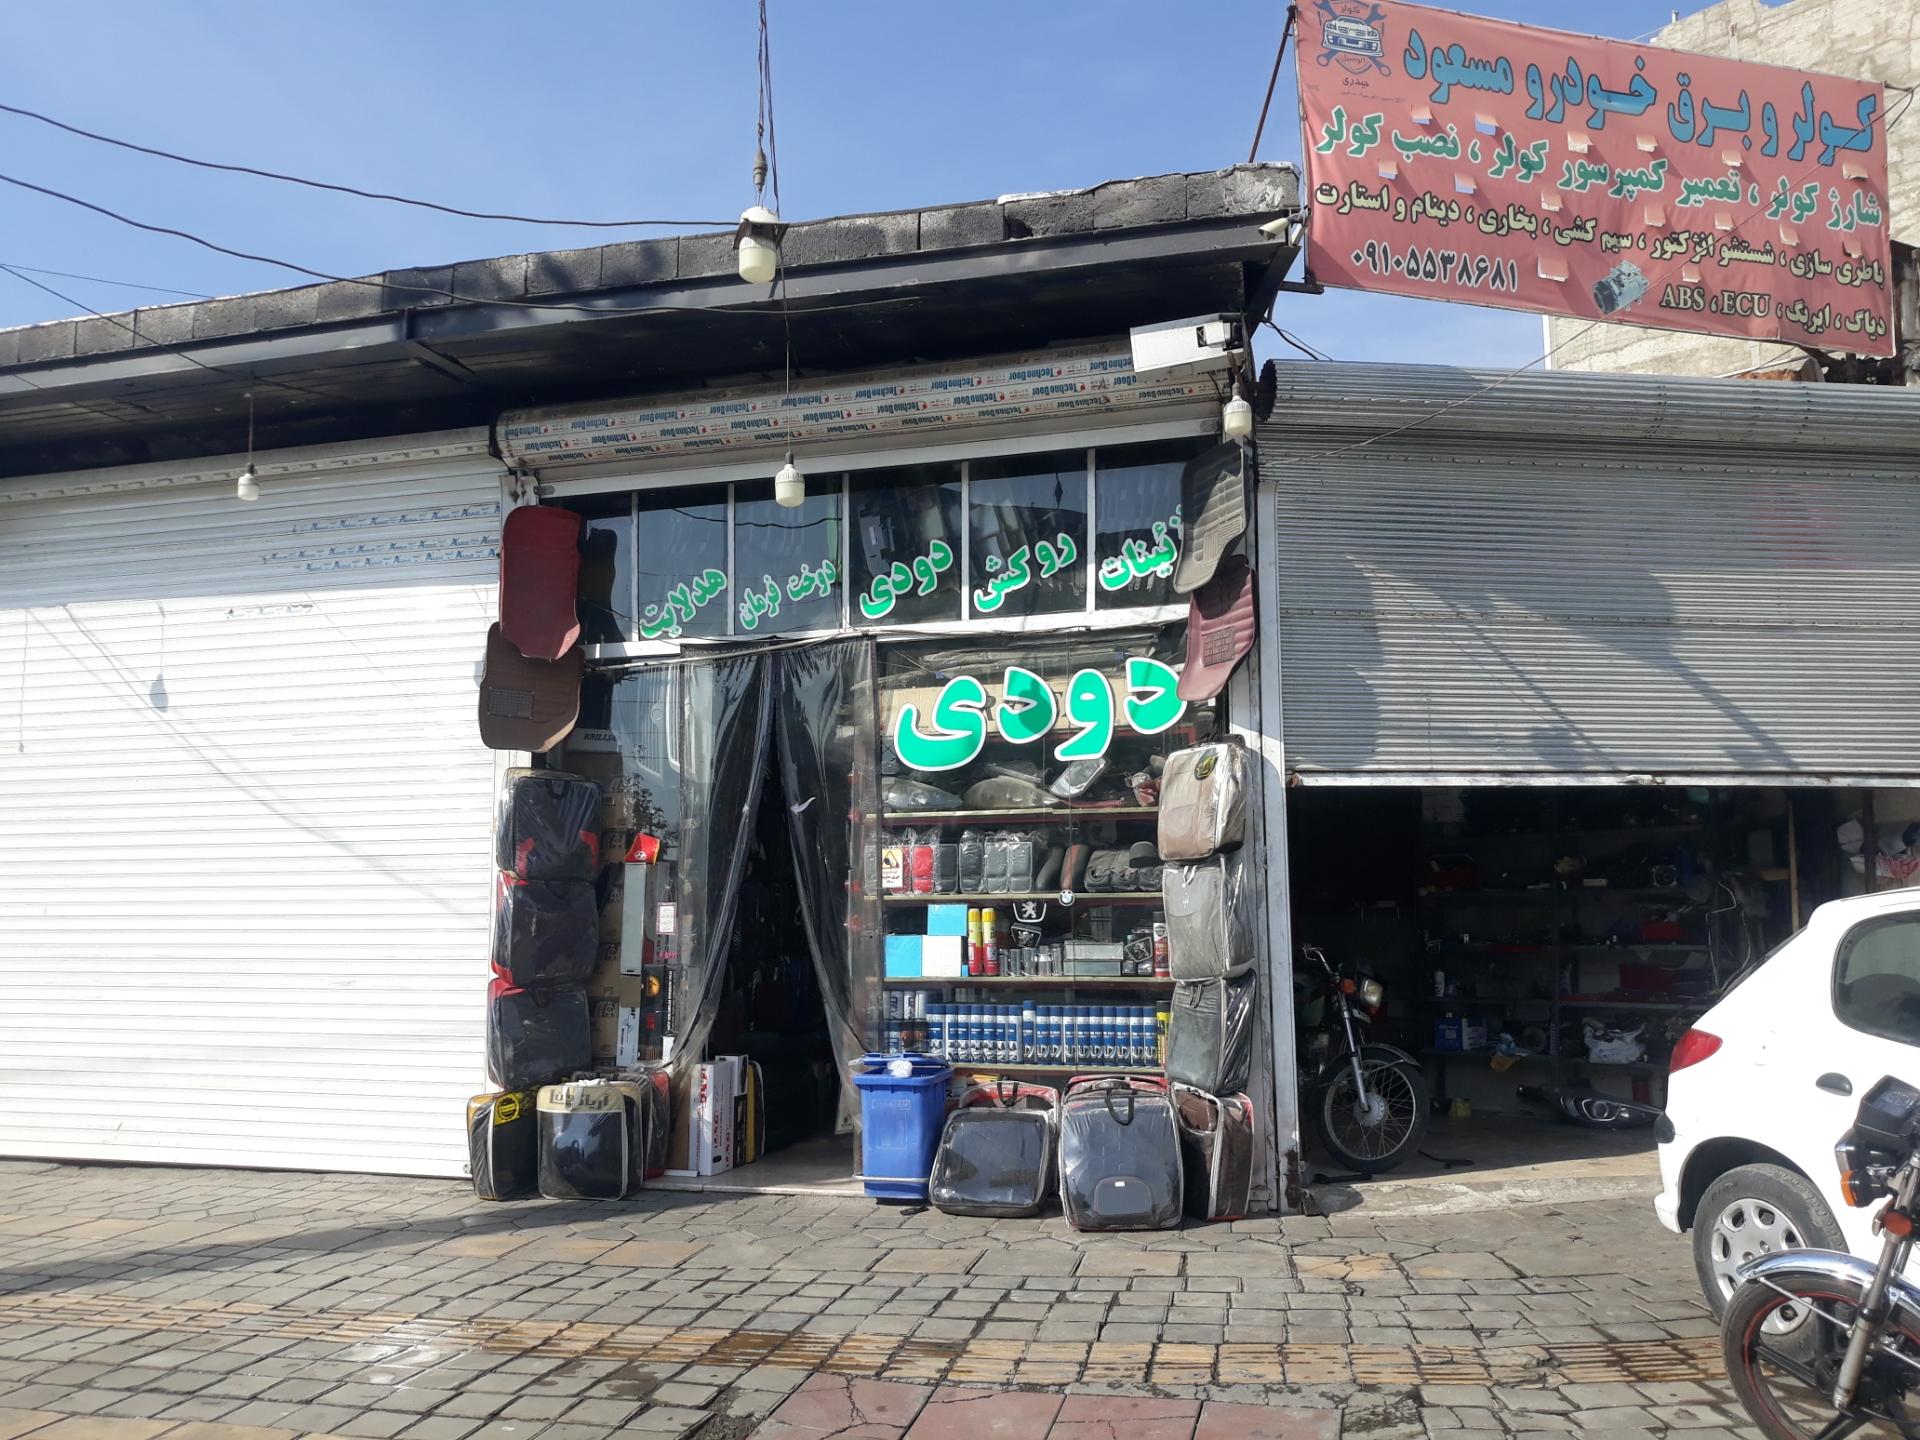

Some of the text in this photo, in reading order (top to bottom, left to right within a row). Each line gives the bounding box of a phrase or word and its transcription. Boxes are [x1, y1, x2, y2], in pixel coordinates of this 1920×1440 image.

[1403, 28, 1515, 105] مسعود
[1315, 105, 1384, 156] کولر
[1667, 72, 1753, 150] برق
[1760, 101, 1780, 158] و
[1391, 124, 1462, 164] نصب
[1488, 133, 1550, 183] کولر
[1314, 180, 1390, 215] استارت
[1410, 191, 1461, 227] دینام
[1675, 169, 1742, 207] تعمیر
[1765, 175, 1819, 223] کولر
[1826, 187, 1882, 231] شارژ
[1553, 215, 1598, 246] کشی
[1352, 240, 1518, 291] ۰۹۱۰۵۵۳۸۶۸۱
[1789, 249, 1833, 280] سازی
[1659, 283, 1706, 313] ABS
[1720, 289, 1771, 319] ECU
[859, 539, 954, 619] دودی
[892, 656, 1188, 772] دودی
